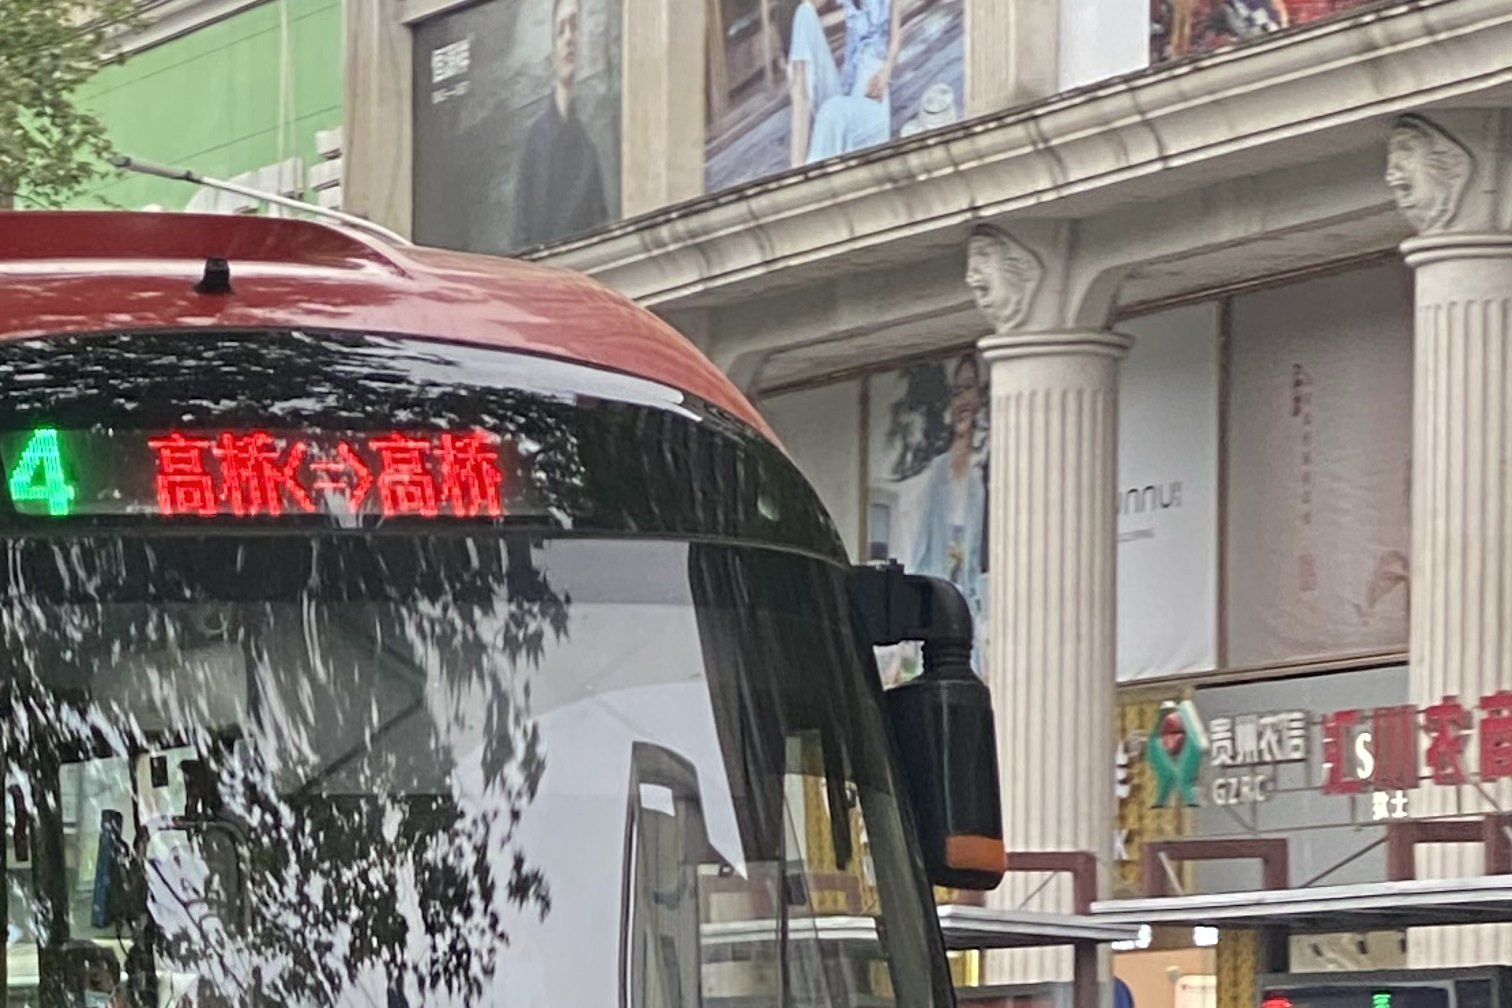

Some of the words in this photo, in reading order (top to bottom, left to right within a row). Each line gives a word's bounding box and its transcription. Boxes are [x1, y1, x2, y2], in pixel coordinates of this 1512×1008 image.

[10, 428, 74, 515] 4
[369, 430, 502, 517] 高桥
[1209, 711, 1306, 767] 贵州农信
